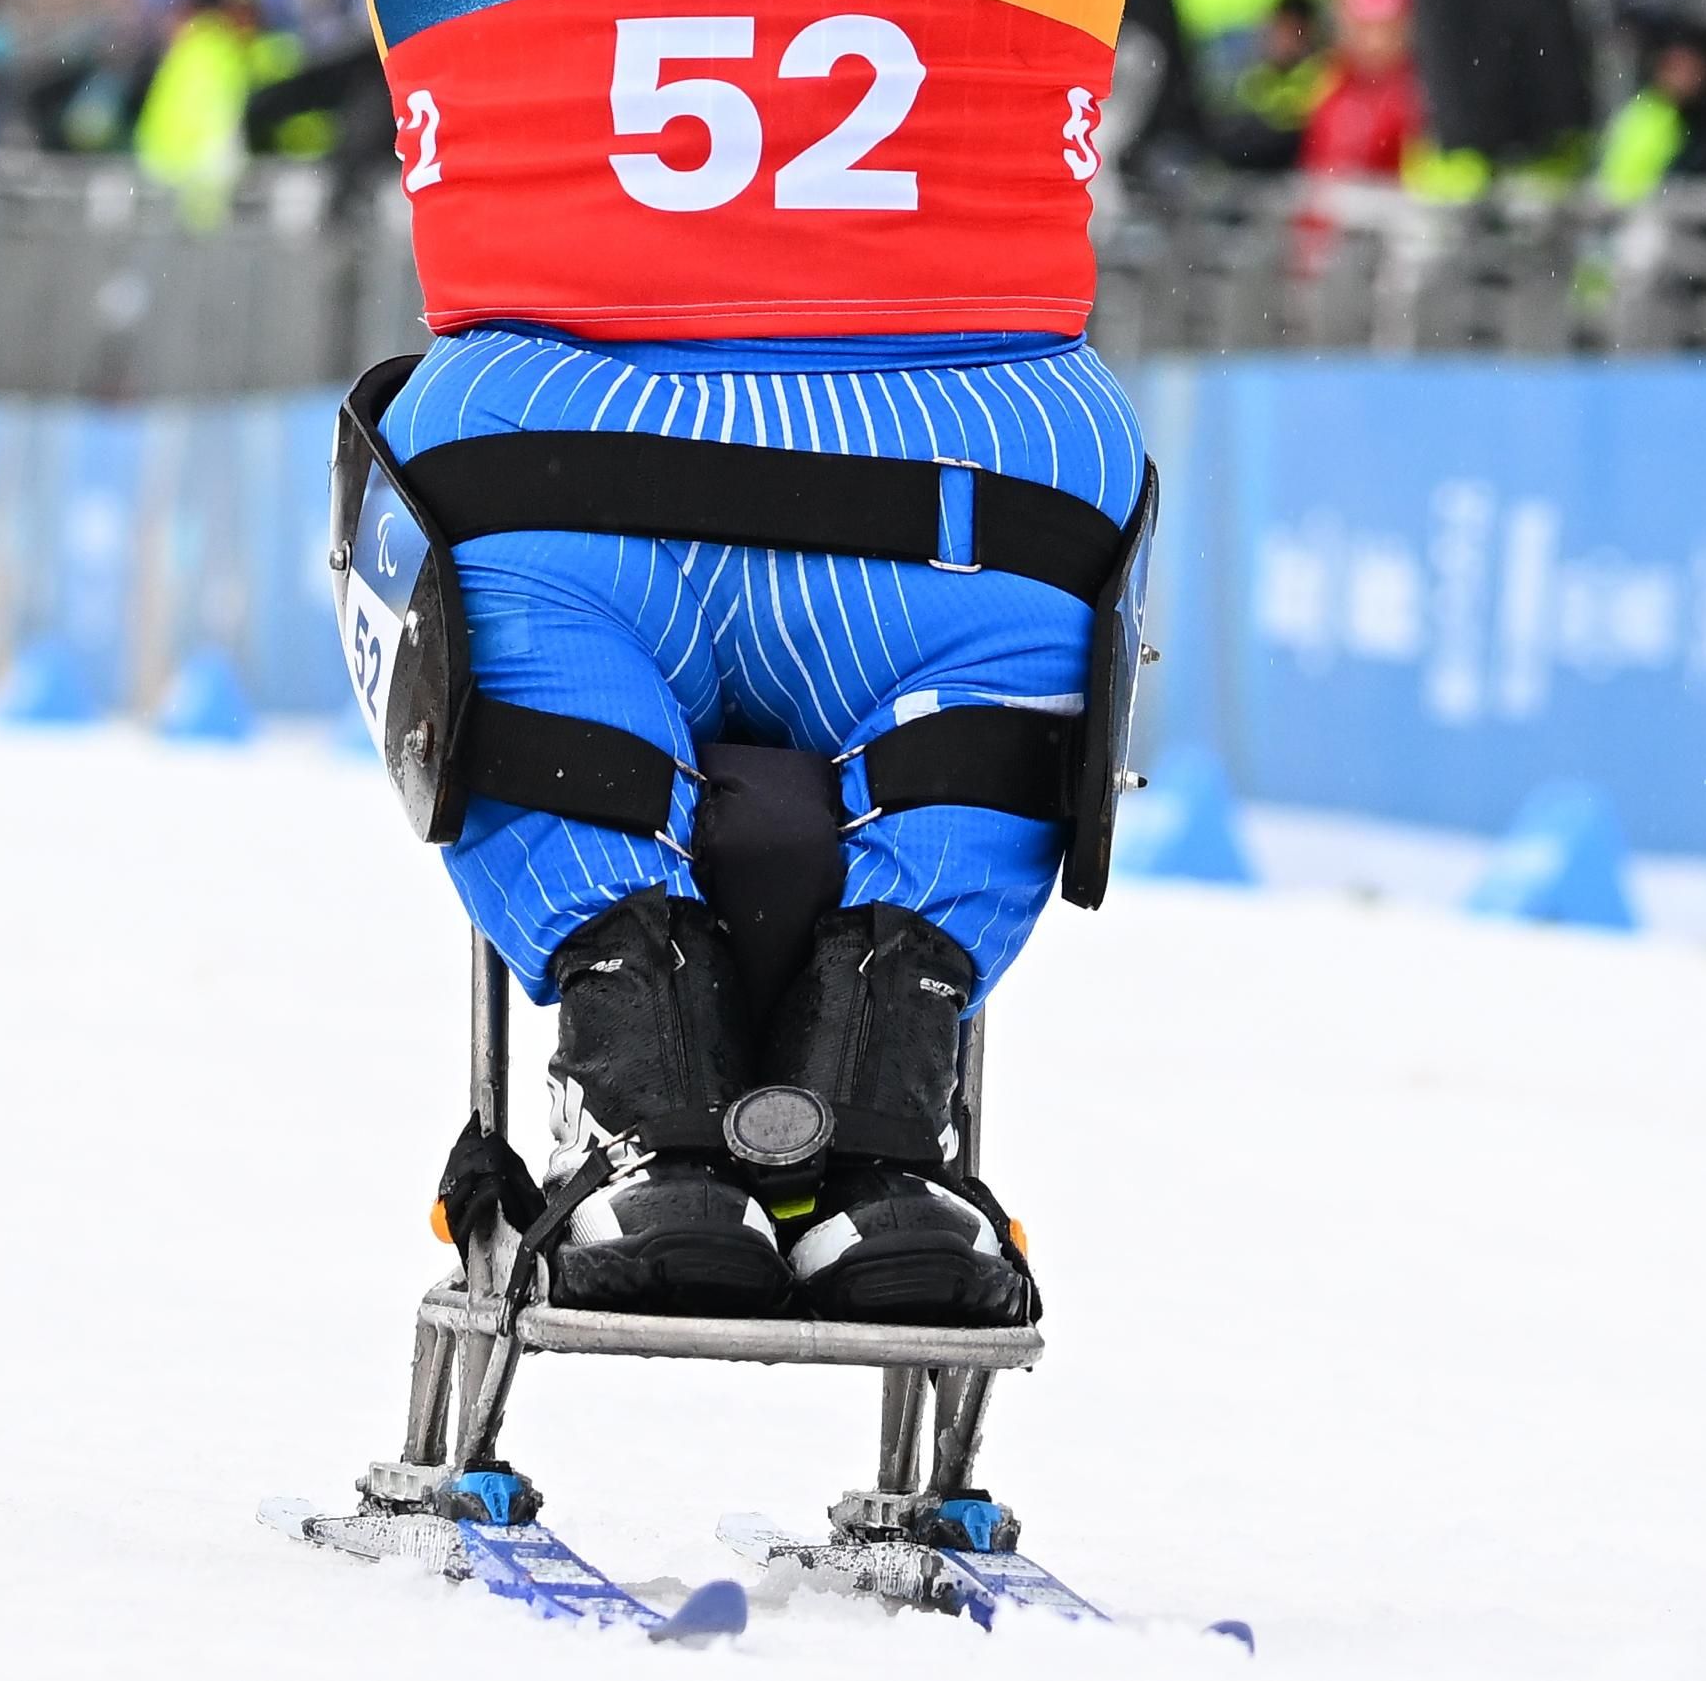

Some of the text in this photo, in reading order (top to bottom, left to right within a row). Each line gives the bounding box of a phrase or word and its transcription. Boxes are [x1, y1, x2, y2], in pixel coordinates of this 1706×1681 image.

[394, 89, 443, 193] 2
[608, 14, 927, 213] 52
[354, 605, 381, 722] 52
